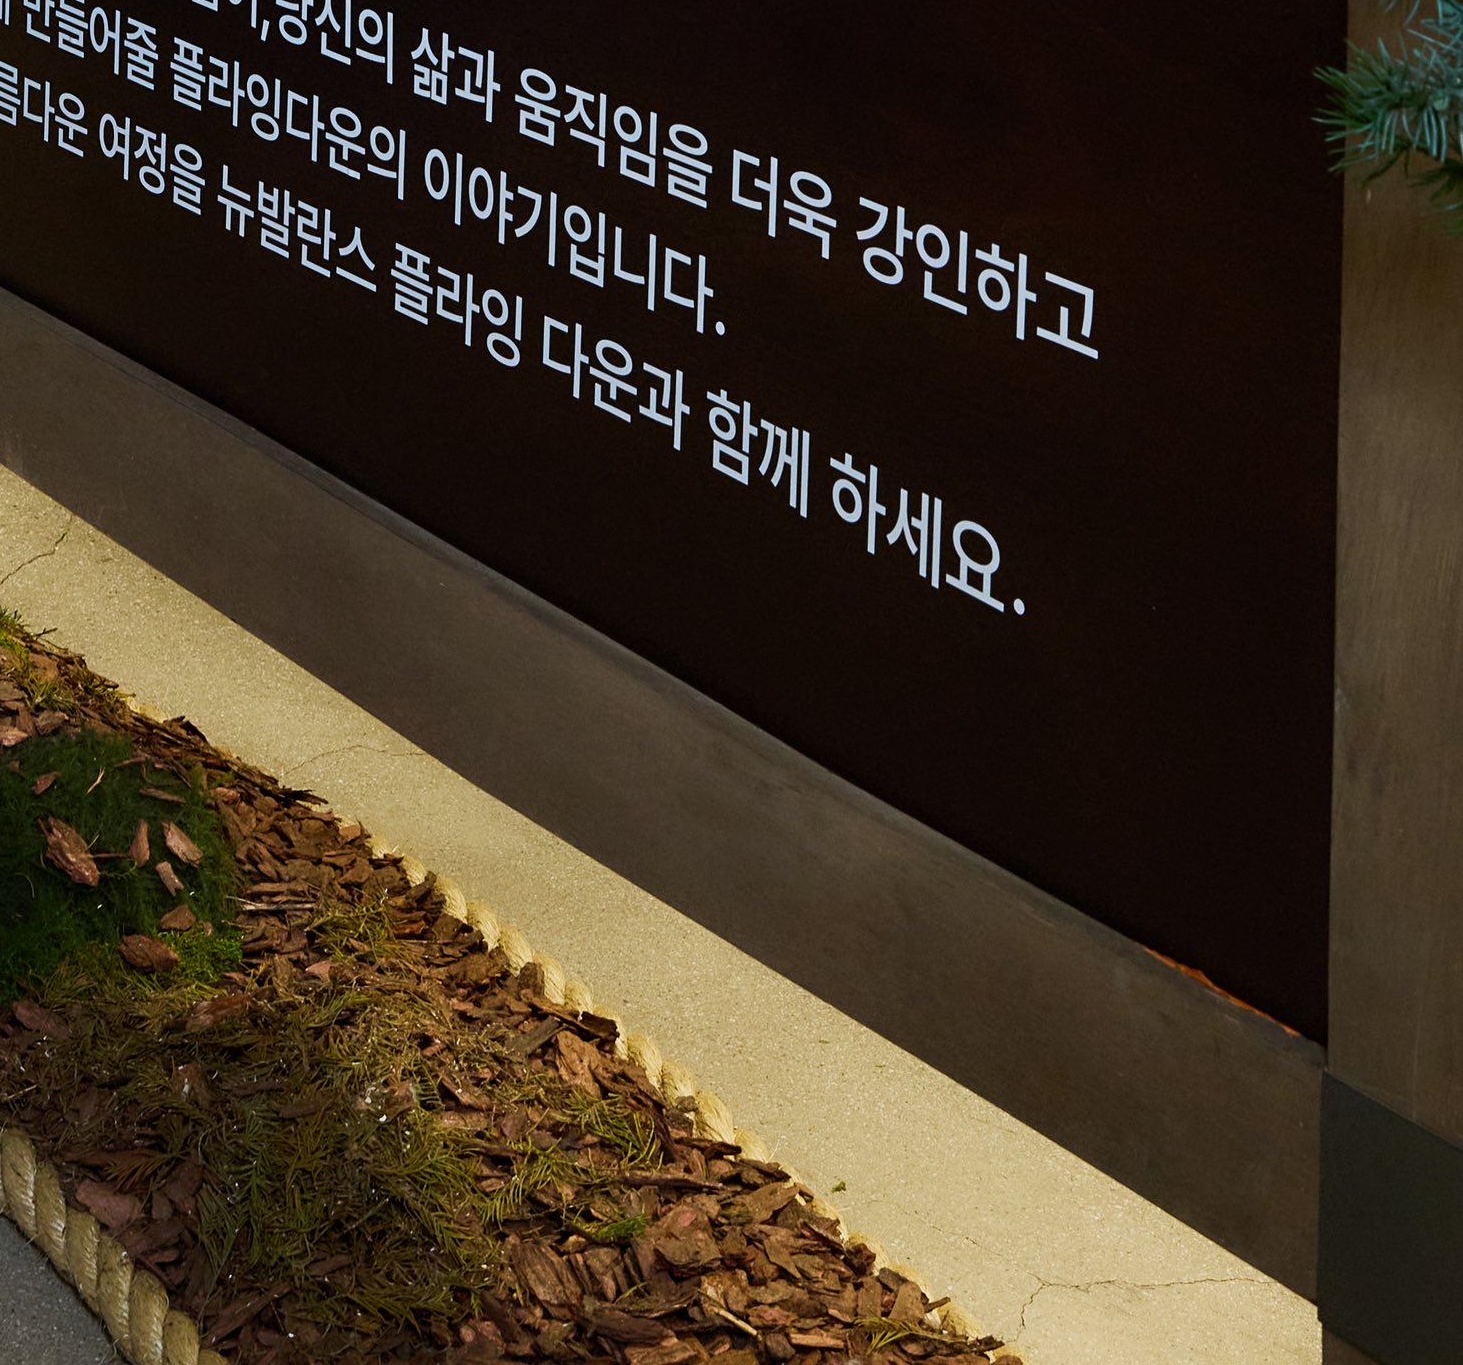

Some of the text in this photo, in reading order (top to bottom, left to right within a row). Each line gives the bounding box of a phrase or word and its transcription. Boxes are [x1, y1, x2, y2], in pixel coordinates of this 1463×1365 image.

[170, 37, 406, 200] 플라잉다운의
[425, 149, 725, 335] 이야기입니다.
[411, 28, 500, 122] 삶과
[515, 68, 712, 208] 움직임을
[732, 149, 837, 259] 더욱
[856, 197, 1098, 359] 강인하고
[99, 113, 205, 215] 여정을
[218, 165, 376, 292] 뉴발란스
[391, 243, 522, 367] 플라잉
[543, 316, 690, 451] 다운과
[707, 389, 810, 518] 함께
[830, 453, 1025, 615] 하세요.
